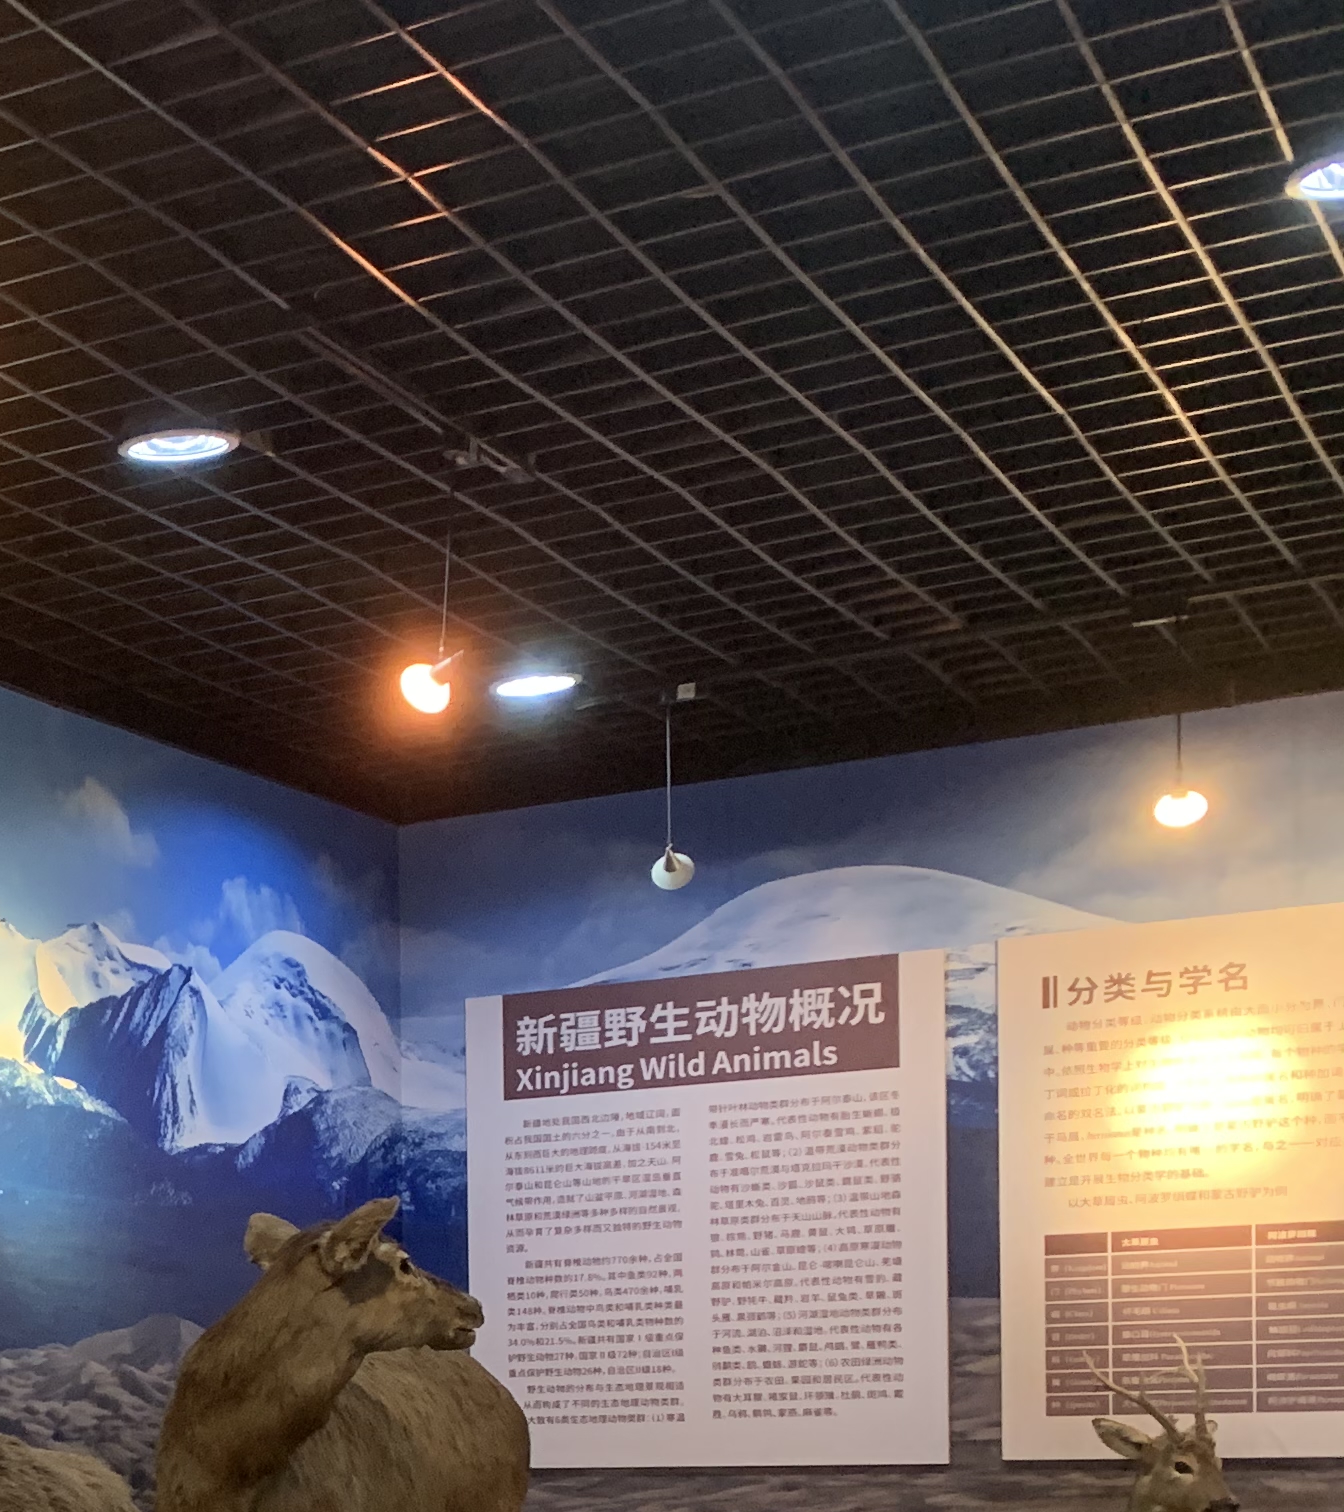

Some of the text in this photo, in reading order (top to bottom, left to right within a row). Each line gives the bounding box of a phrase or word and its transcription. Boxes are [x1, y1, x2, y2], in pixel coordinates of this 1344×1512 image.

[1067, 962, 1248, 1006] 分类与学名
[516, 982, 886, 1056] 新疆野生动物概况
[516, 1041, 838, 1094] Xinjiang Wild Animals
